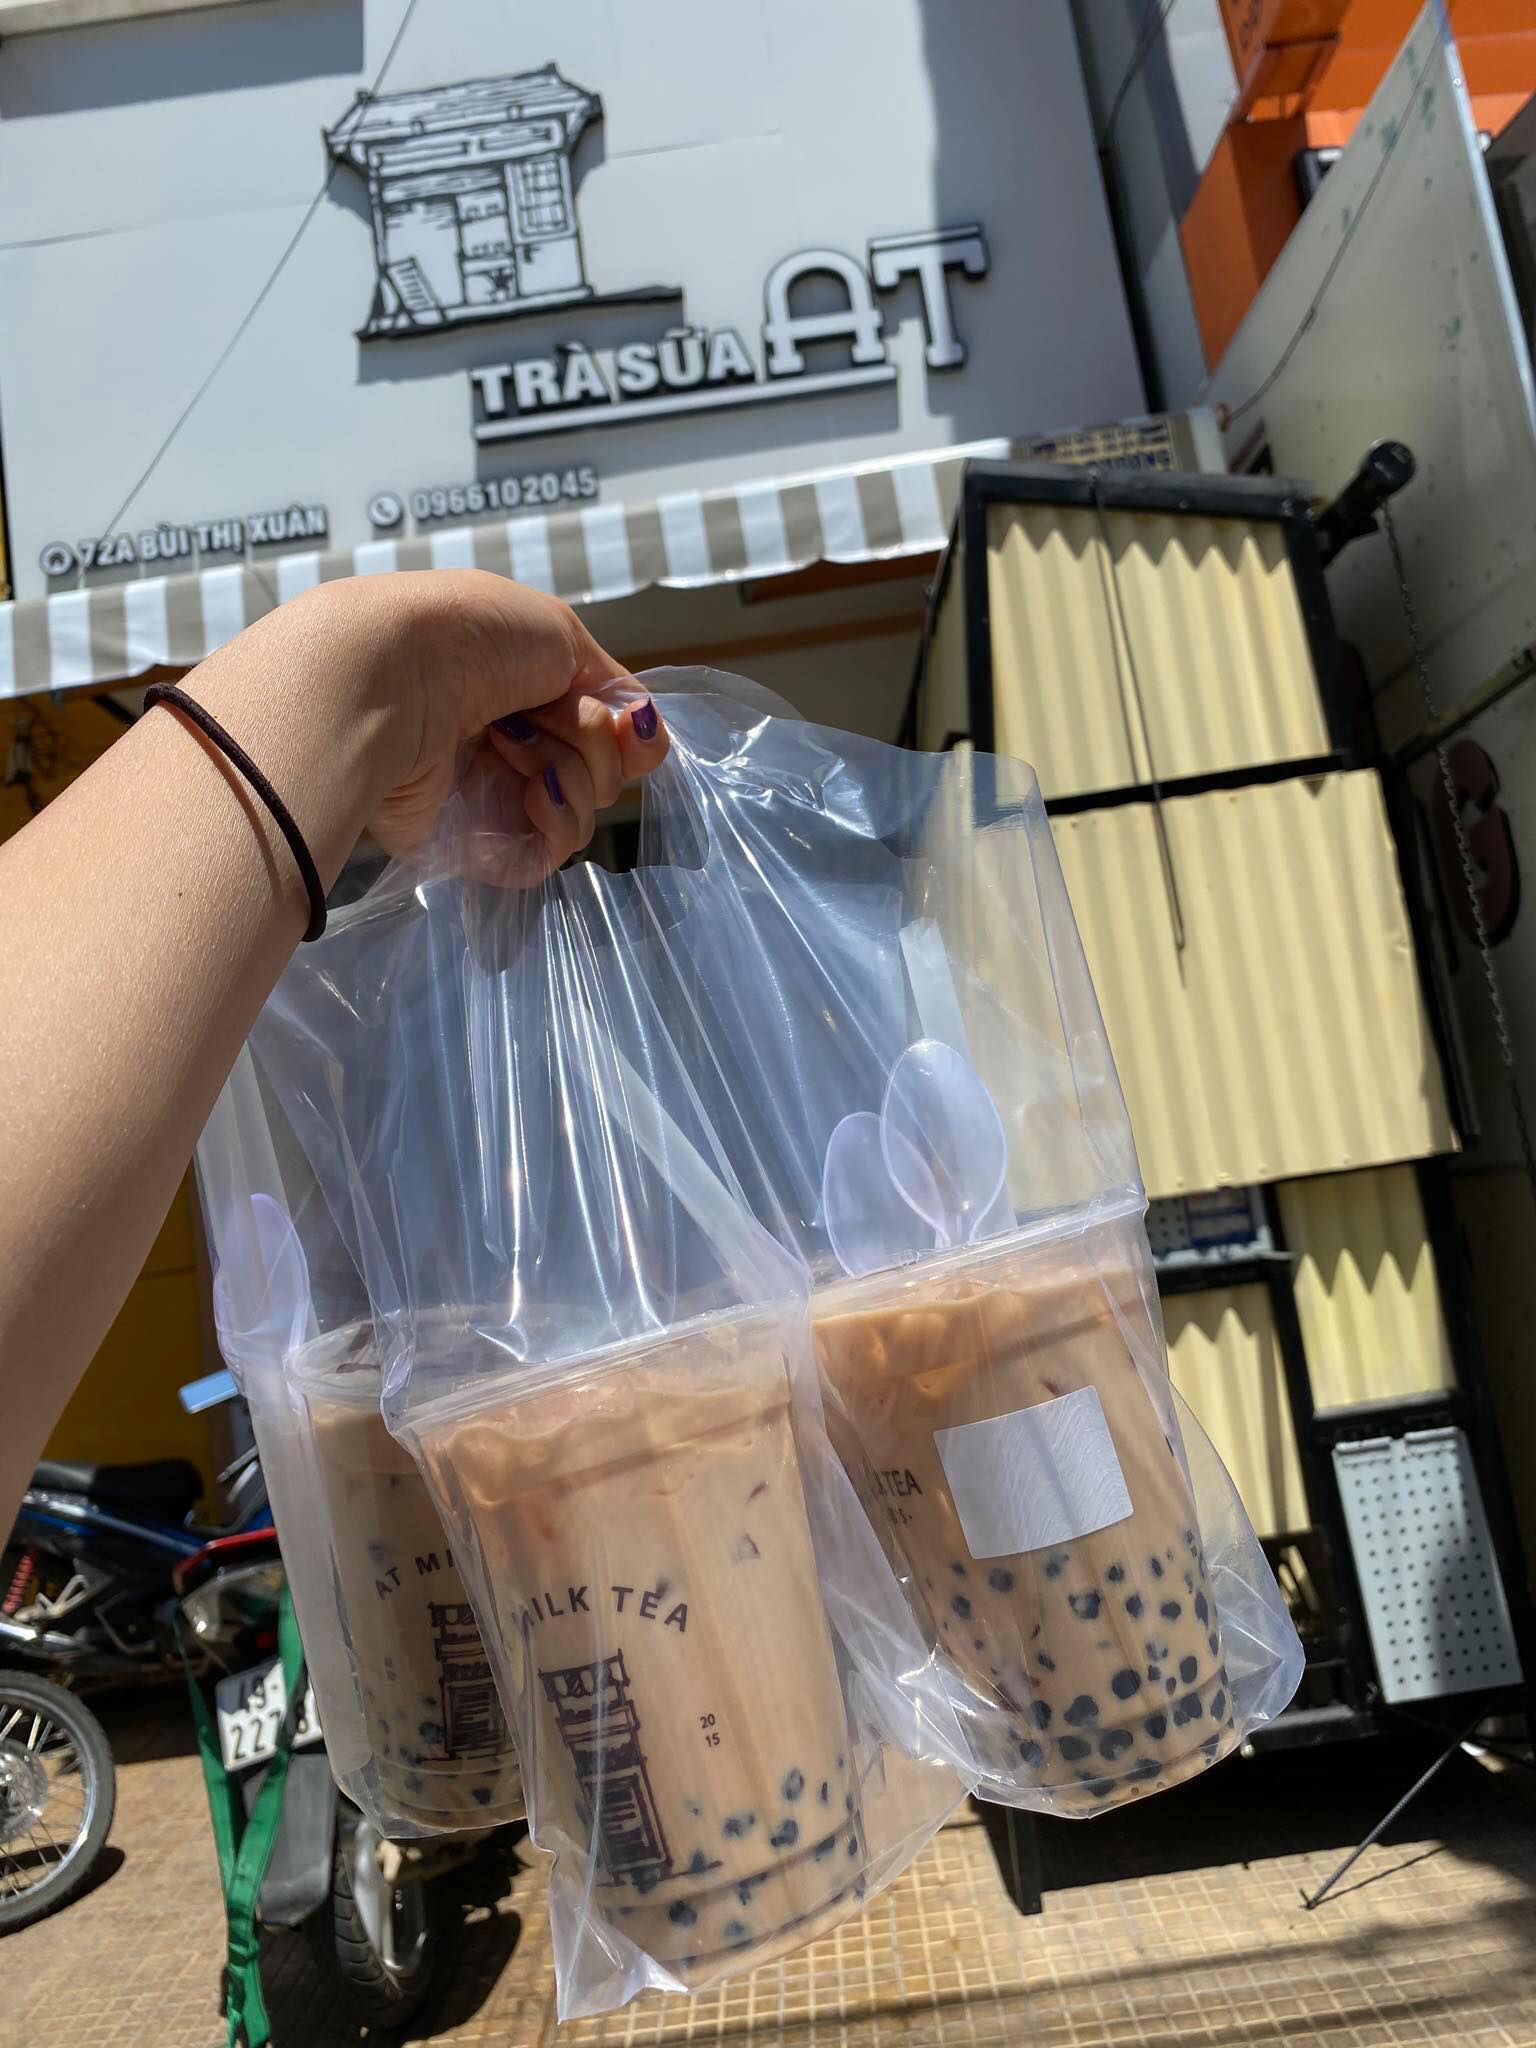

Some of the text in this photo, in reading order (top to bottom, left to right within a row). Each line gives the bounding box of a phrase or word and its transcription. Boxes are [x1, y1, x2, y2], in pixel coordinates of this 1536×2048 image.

[470, 343, 609, 414] TRÀ
[763, 223, 987, 376] AT
[411, 466, 599, 520] 0966102045
[78, 503, 328, 567] 72A BÙI THỊ XUÂN
[374, 1549, 454, 1600] AT MI
[611, 1585, 689, 1633] TEA
[700, 1712, 716, 1730] 20
[704, 1732, 721, 1748] 15
